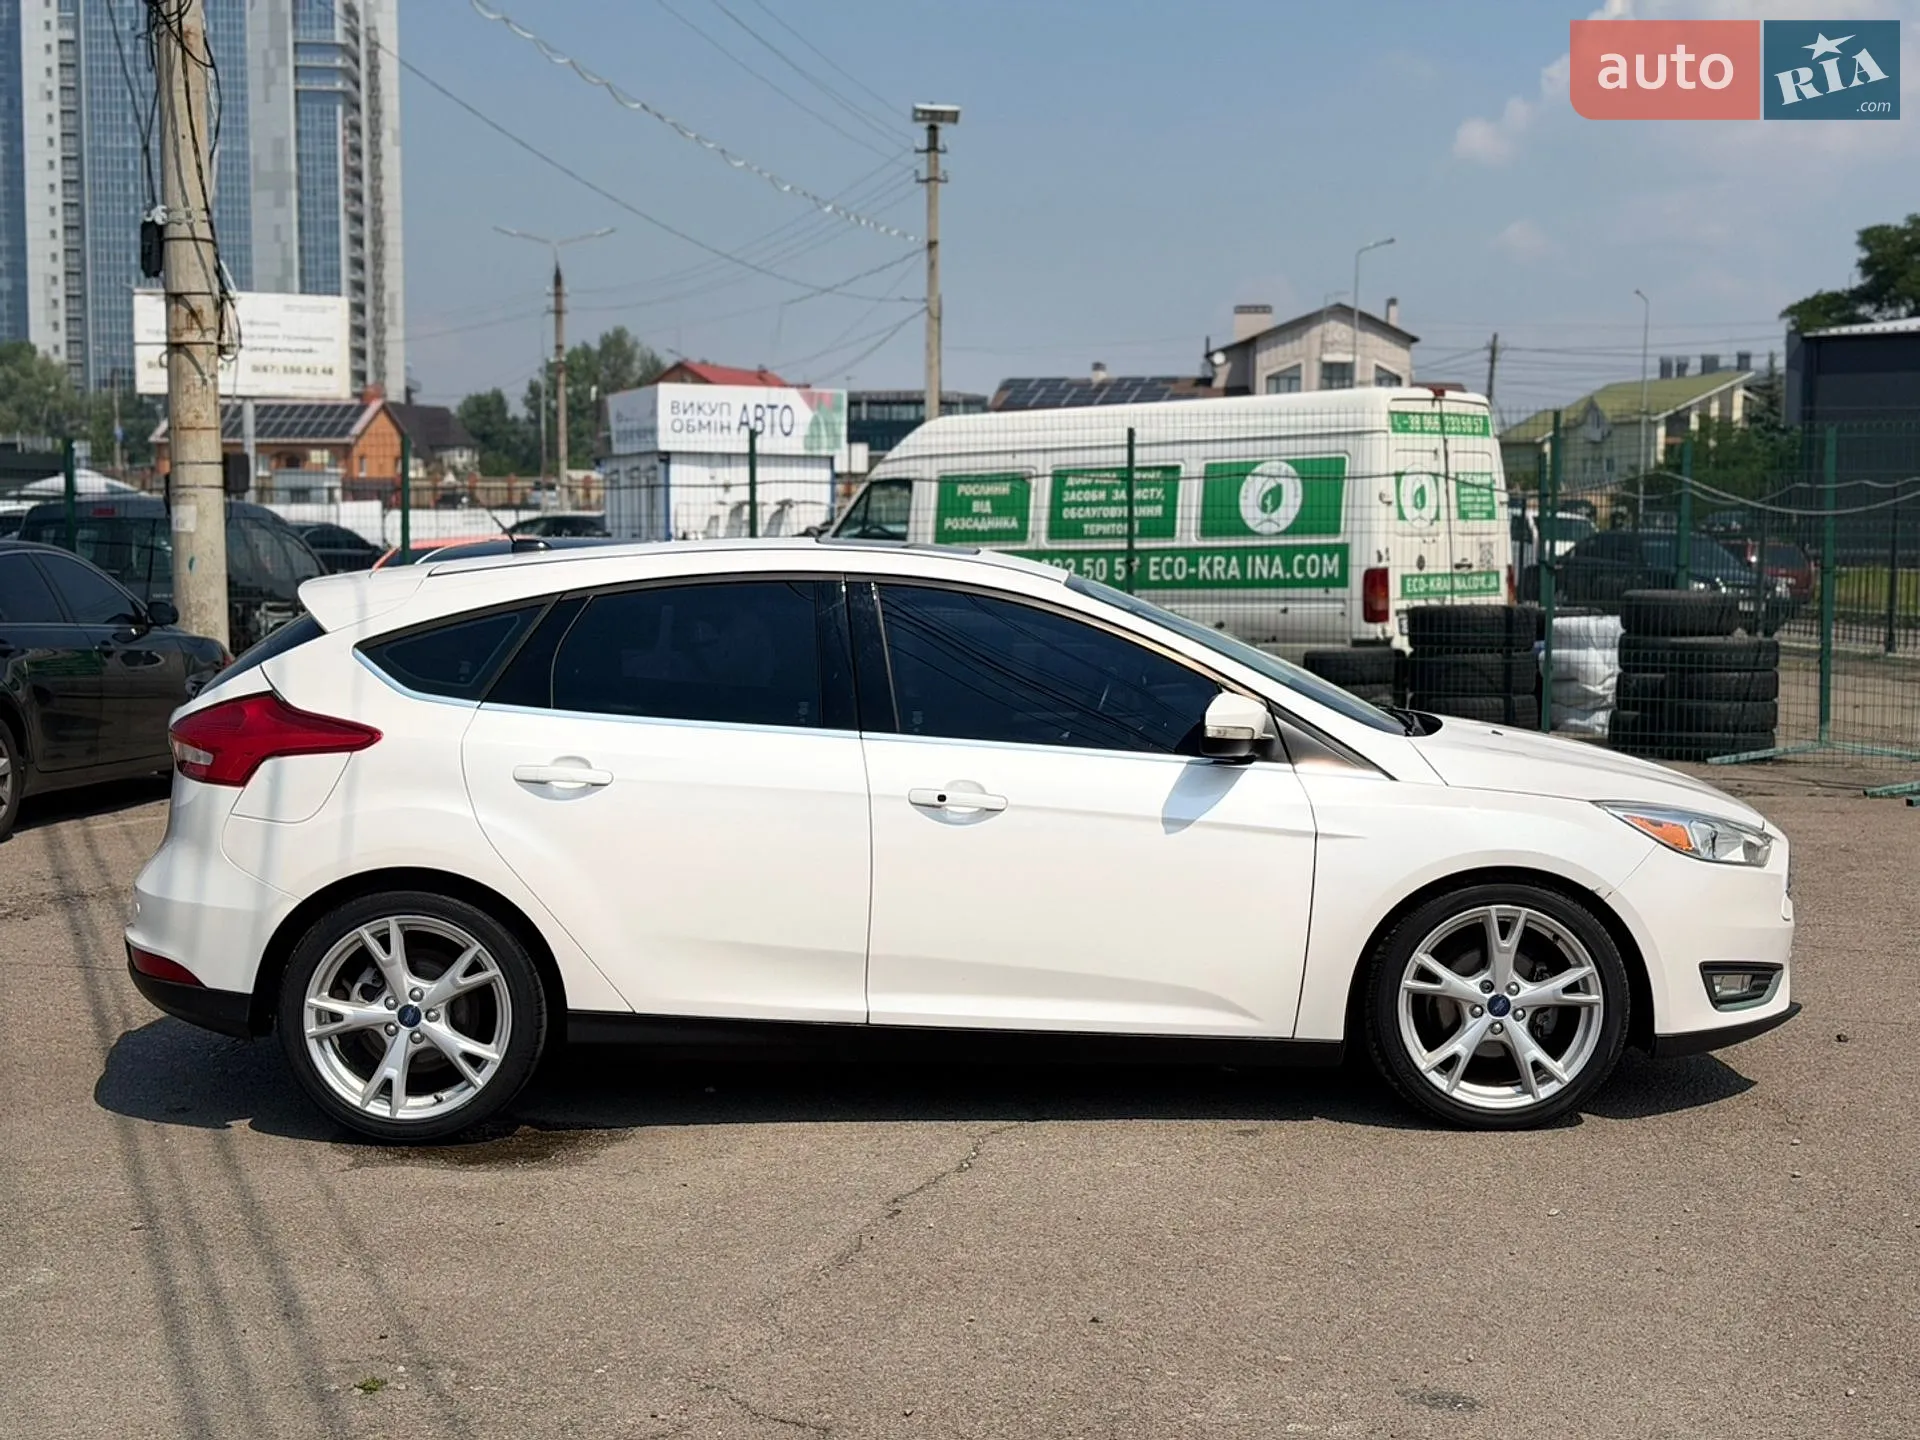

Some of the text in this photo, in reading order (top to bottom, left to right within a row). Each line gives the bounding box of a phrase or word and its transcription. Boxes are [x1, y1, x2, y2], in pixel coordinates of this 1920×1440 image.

[670, 400, 732, 417] ВИКУП
[670, 418, 732, 435] ОБМІН
[737, 403, 795, 437] АВТО
[1062, 487, 1165, 503] ЗАСОБИ ЗАИСТУ,
[944, 516, 1019, 532] РОЗСАДНИКА
